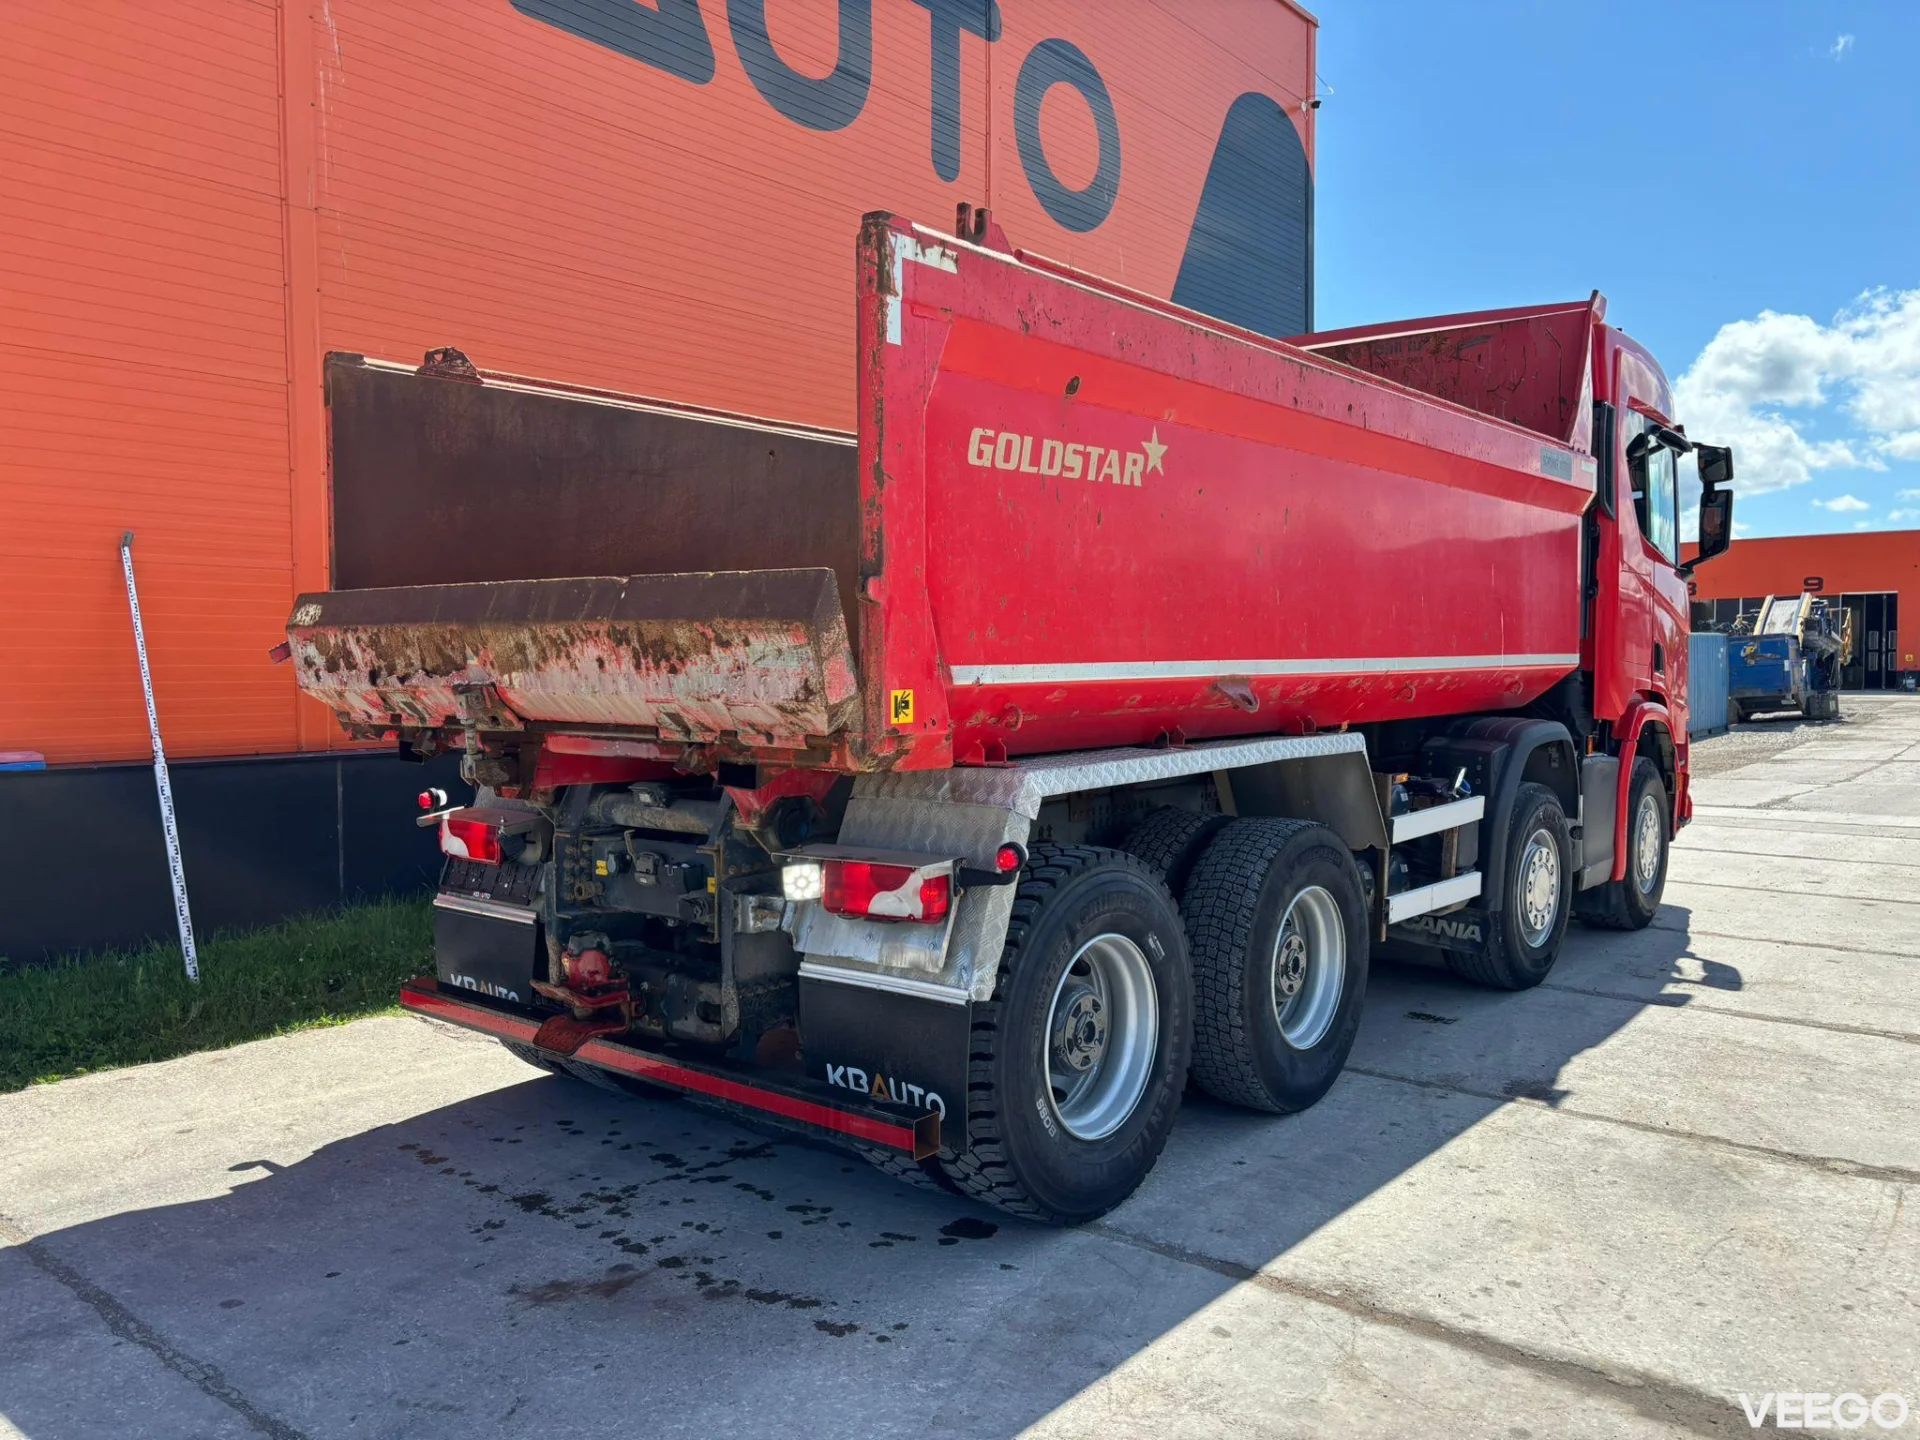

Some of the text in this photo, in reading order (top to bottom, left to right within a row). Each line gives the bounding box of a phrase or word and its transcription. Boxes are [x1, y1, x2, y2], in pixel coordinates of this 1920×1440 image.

[967, 427, 1145, 487] GOLDSTAR
[1803, 576, 1824, 592] 9
[1400, 914, 1482, 942] CANIA
[826, 1063, 946, 1122] KBAUTO
